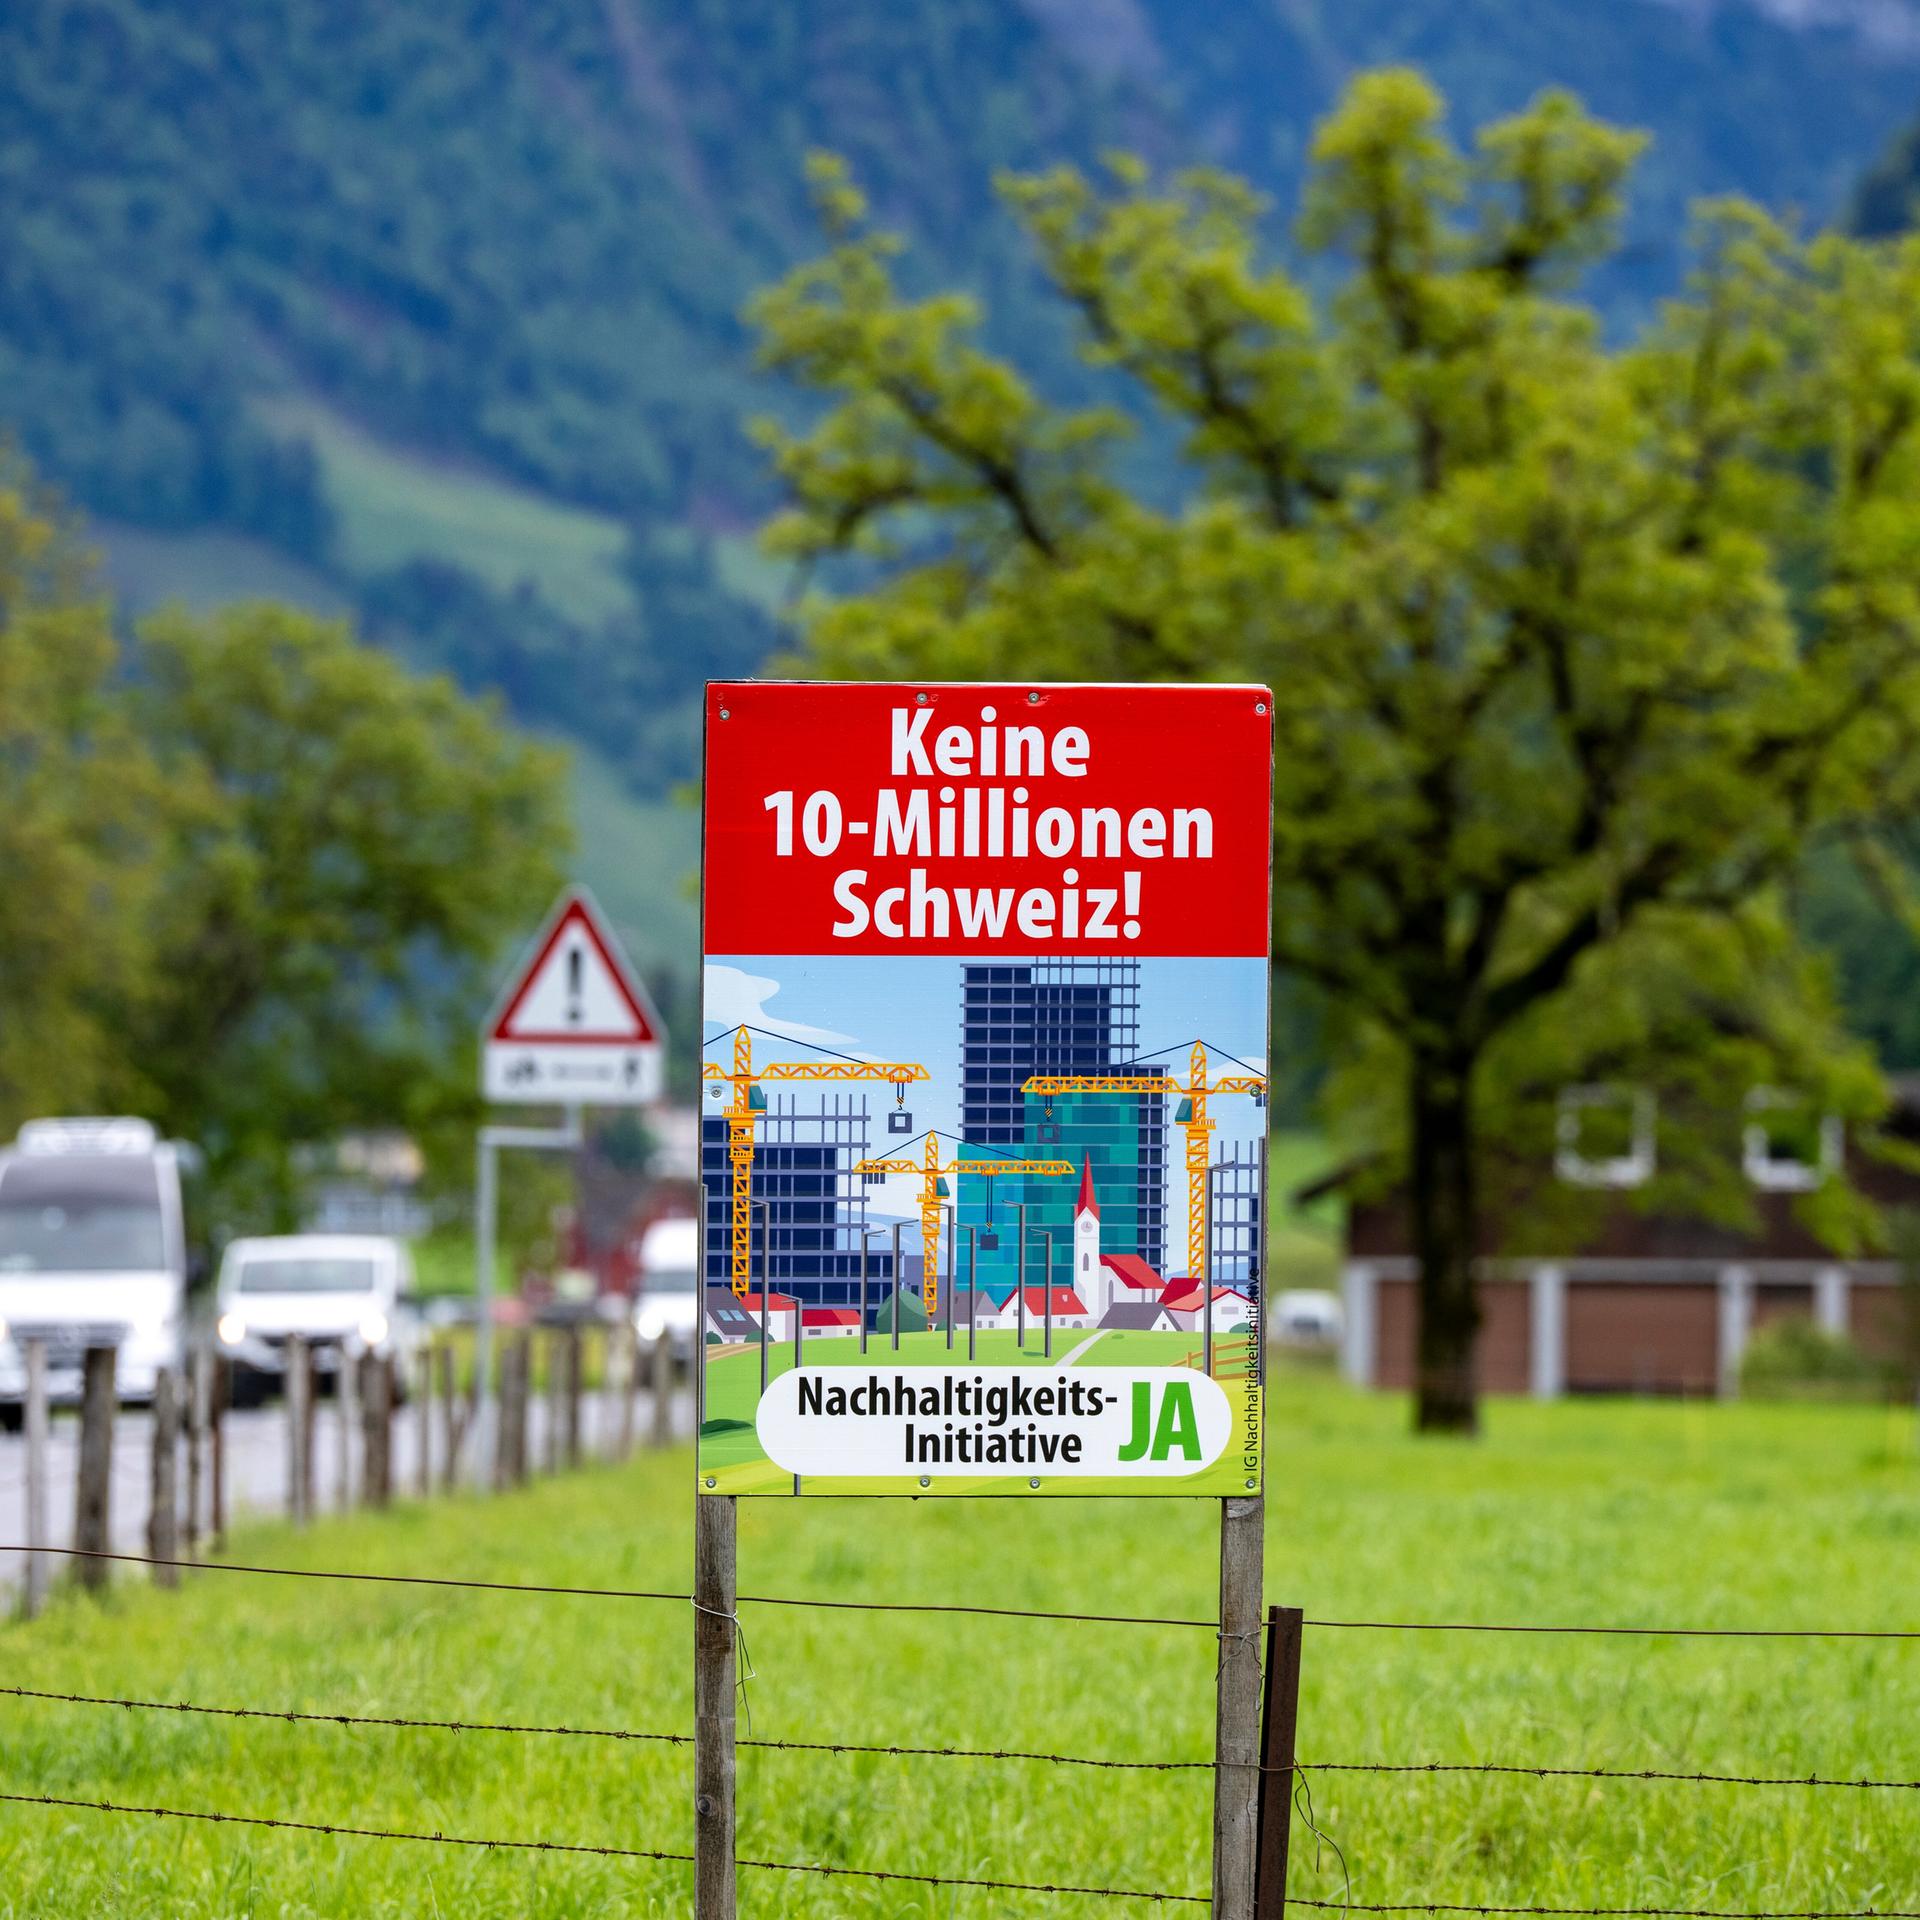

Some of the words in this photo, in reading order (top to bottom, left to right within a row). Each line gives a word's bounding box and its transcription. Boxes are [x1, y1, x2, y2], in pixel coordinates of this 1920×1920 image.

[891, 705, 1090, 777] Keine
[764, 787, 1213, 859] 10-Millionen
[832, 868, 1141, 940] Schweiz!
[1244, 1267, 1261, 1451] Nachhaltigkeitsinitiative
[798, 1376, 1118, 1426] Nachhaltigkeits-
[1118, 1382, 1202, 1461] JA
[905, 1424, 1082, 1463] Initiative
[1244, 1454, 1258, 1472] IG
